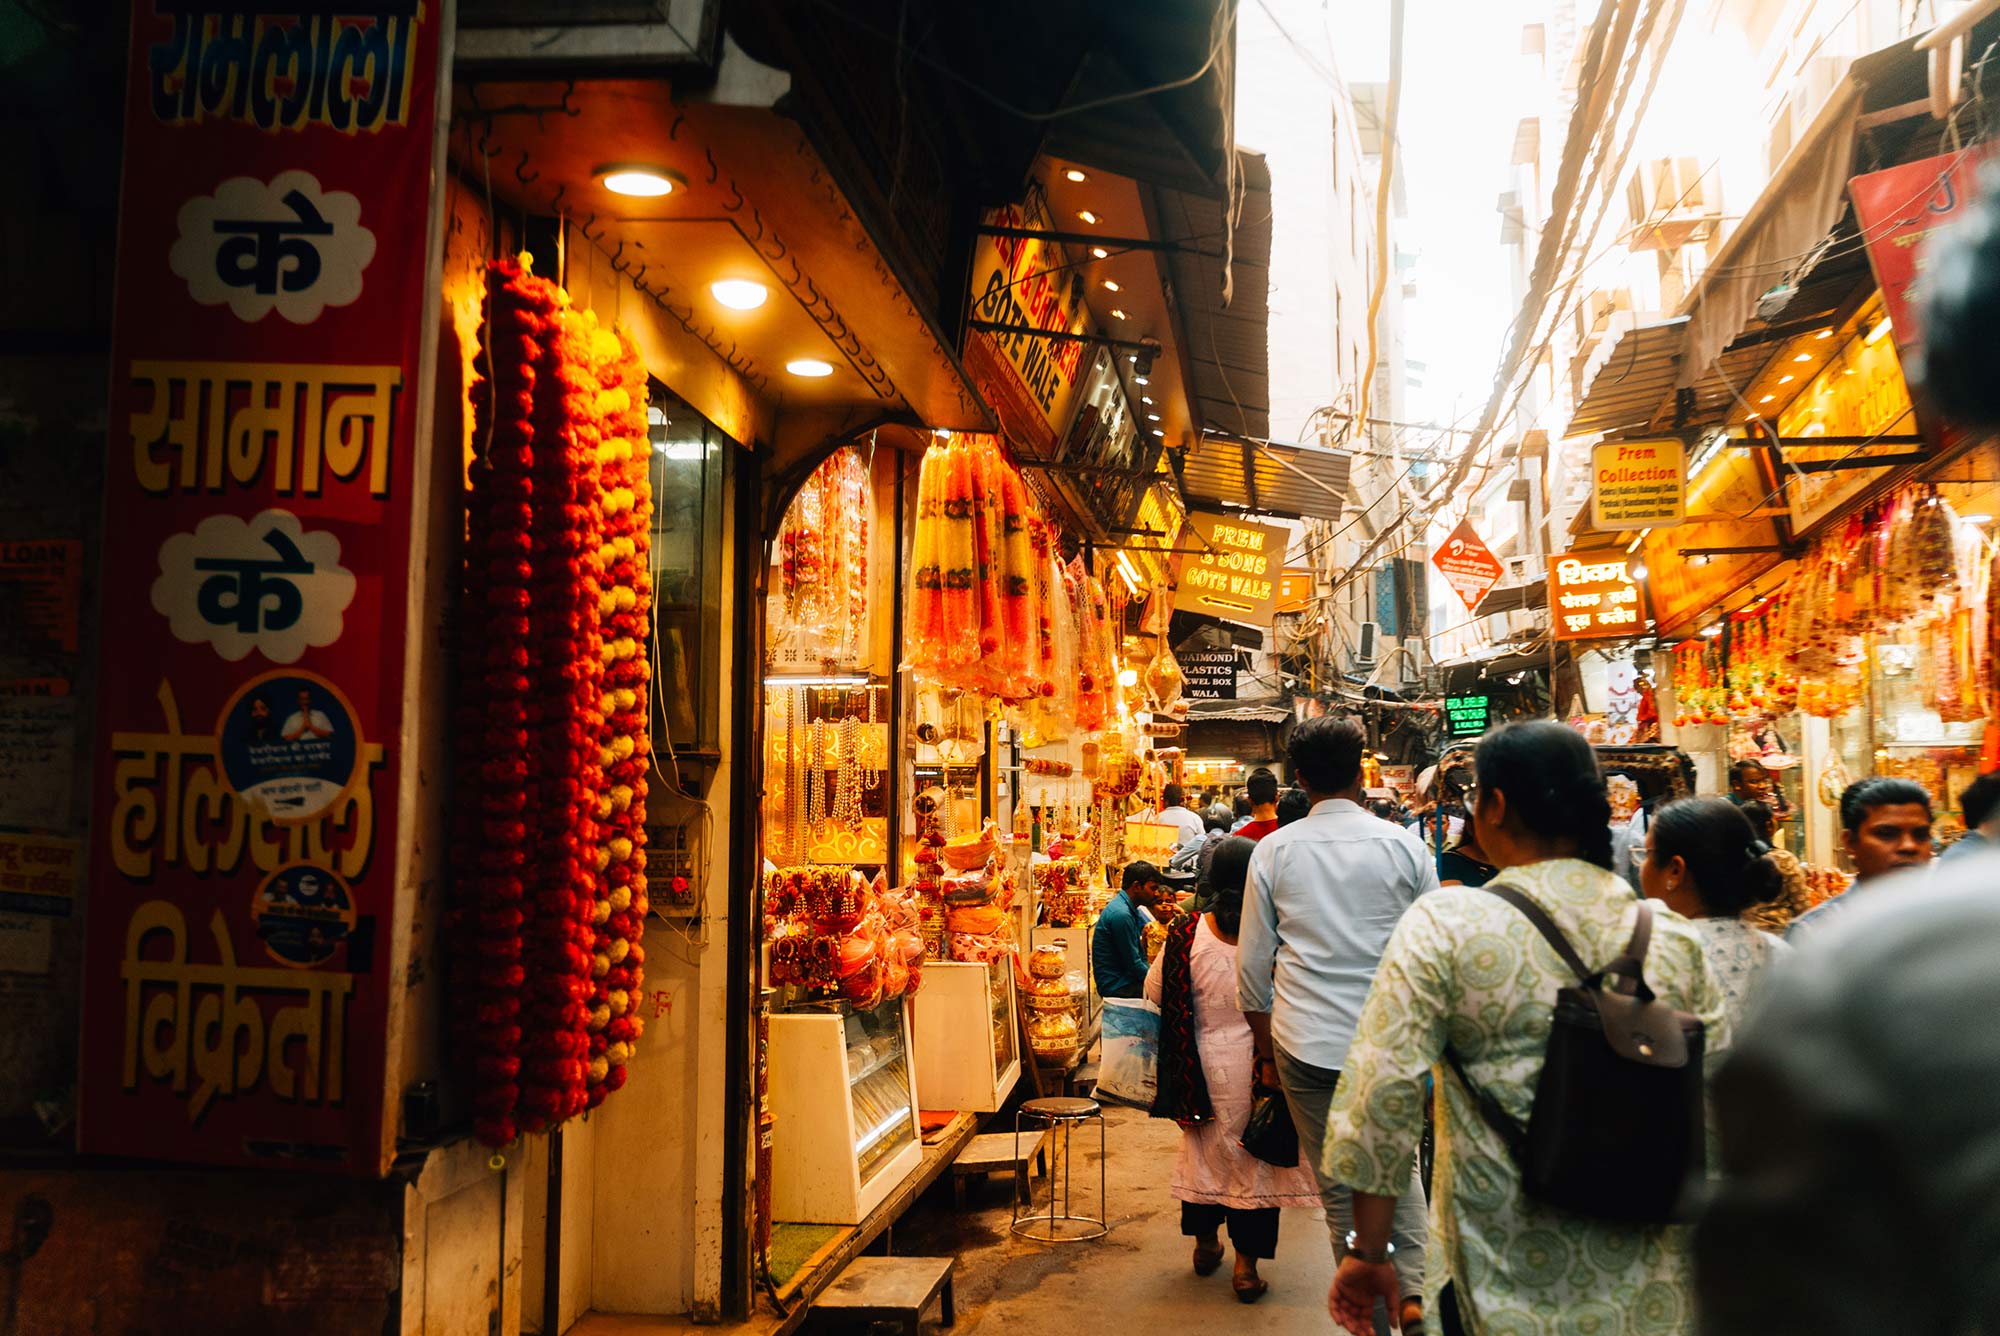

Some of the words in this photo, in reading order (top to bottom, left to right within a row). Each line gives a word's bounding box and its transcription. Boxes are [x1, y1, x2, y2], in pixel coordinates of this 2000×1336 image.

[212, 188, 334, 296] के
[983, 269, 1029, 363] GOTE
[1020, 335, 1061, 416] WALE
[130, 360, 403, 498] सामान
[1618, 446, 1657, 461] Prem
[1599, 466, 1678, 483] Collection
[1212, 523, 1266, 551] PREM
[3, 544, 66, 561] LOAN
[1218, 550, 1268, 575] SONS
[195, 527, 315, 634] के
[1186, 566, 1228, 592] GOTE
[1231, 576, 1273, 601] WALE
[1556, 559, 1635, 586] शिवम्
[1180, 653, 1234, 663] DAIMOND
[1180, 665, 1232, 675] PLASTICS
[1186, 678, 1211, 686] EWEL
[1212, 678, 1232, 686] BOX
[1191, 690, 1220, 698] WALA
[112, 678, 385, 880] होलल
[120, 899, 354, 1125] विक्रेता
